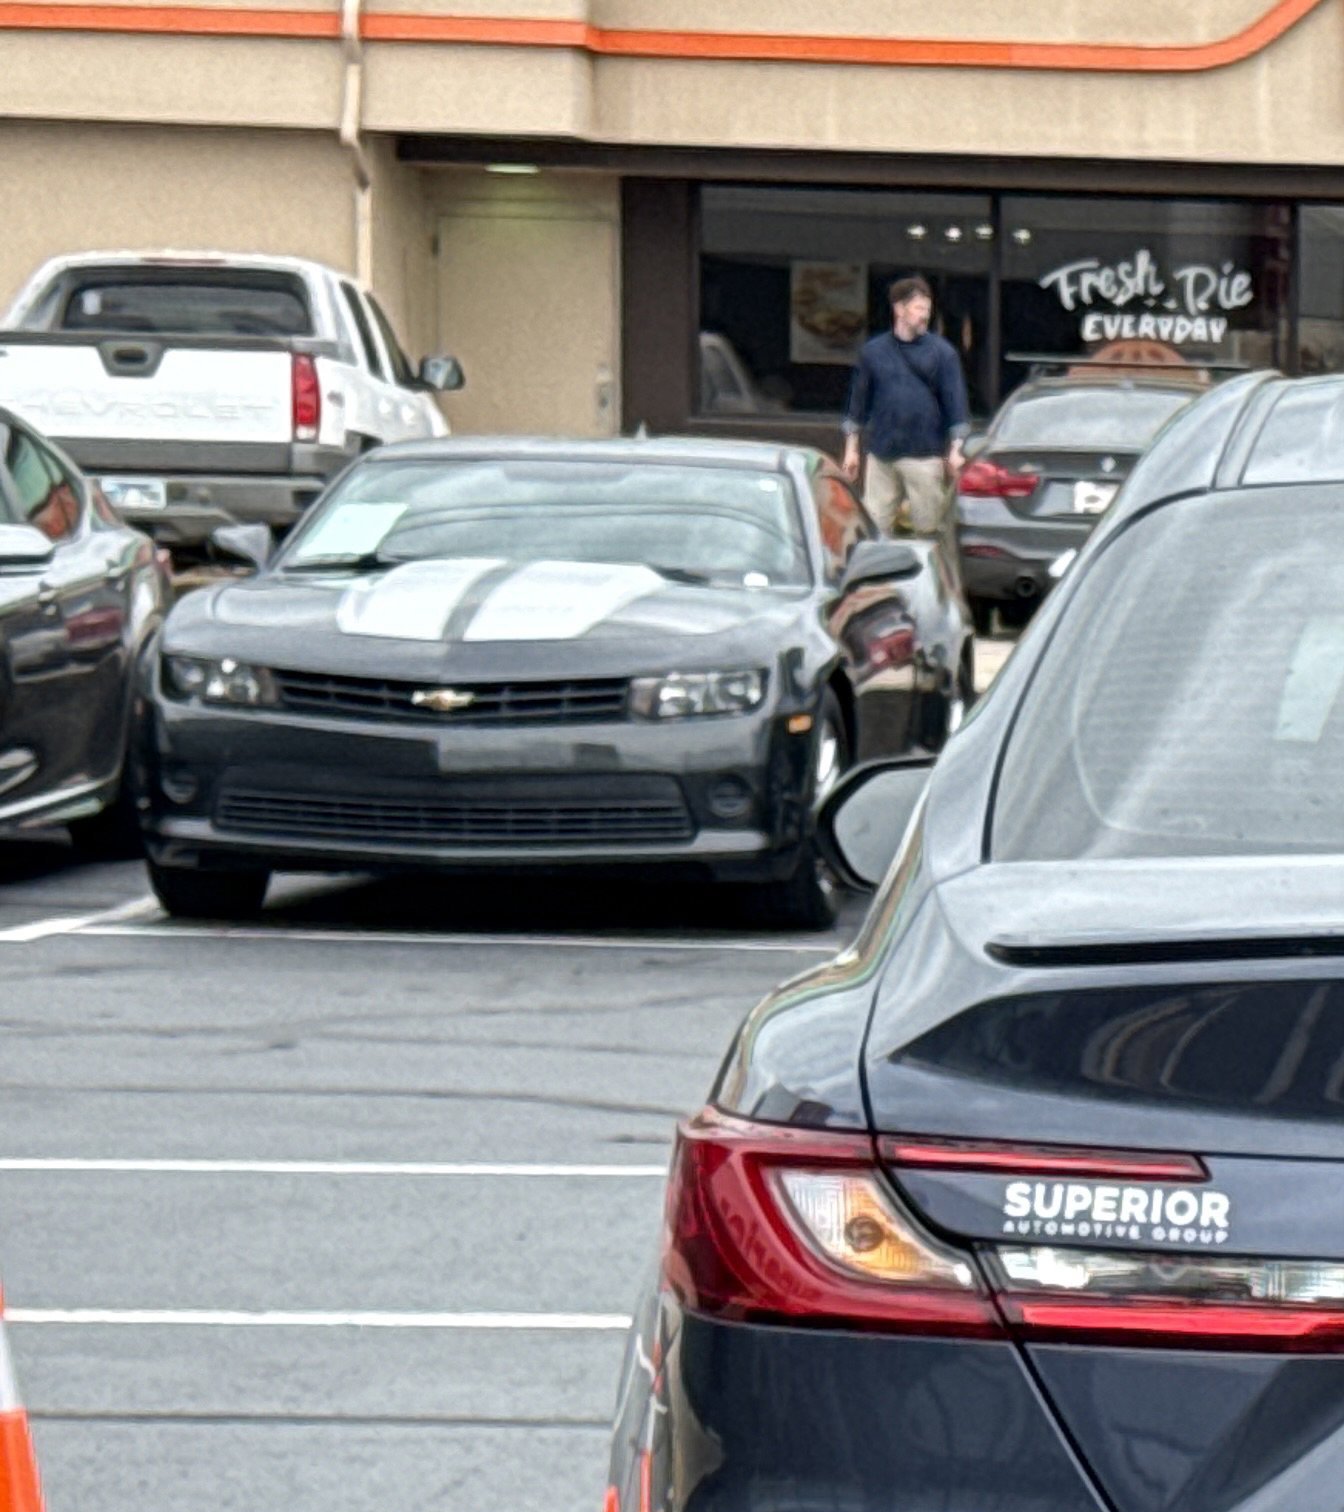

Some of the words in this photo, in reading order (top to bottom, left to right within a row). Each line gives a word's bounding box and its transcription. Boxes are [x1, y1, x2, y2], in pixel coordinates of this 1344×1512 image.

[1039, 249, 1165, 311] Fresh
[1173, 261, 1253, 316] Pie
[1081, 311, 1228, 345] EVERYDAY
[1003, 1181, 1230, 1228] SUPERIOR
[1003, 1220, 1140, 1240] AUTOMOTIVE
[1151, 1226, 1228, 1244] GROUP
